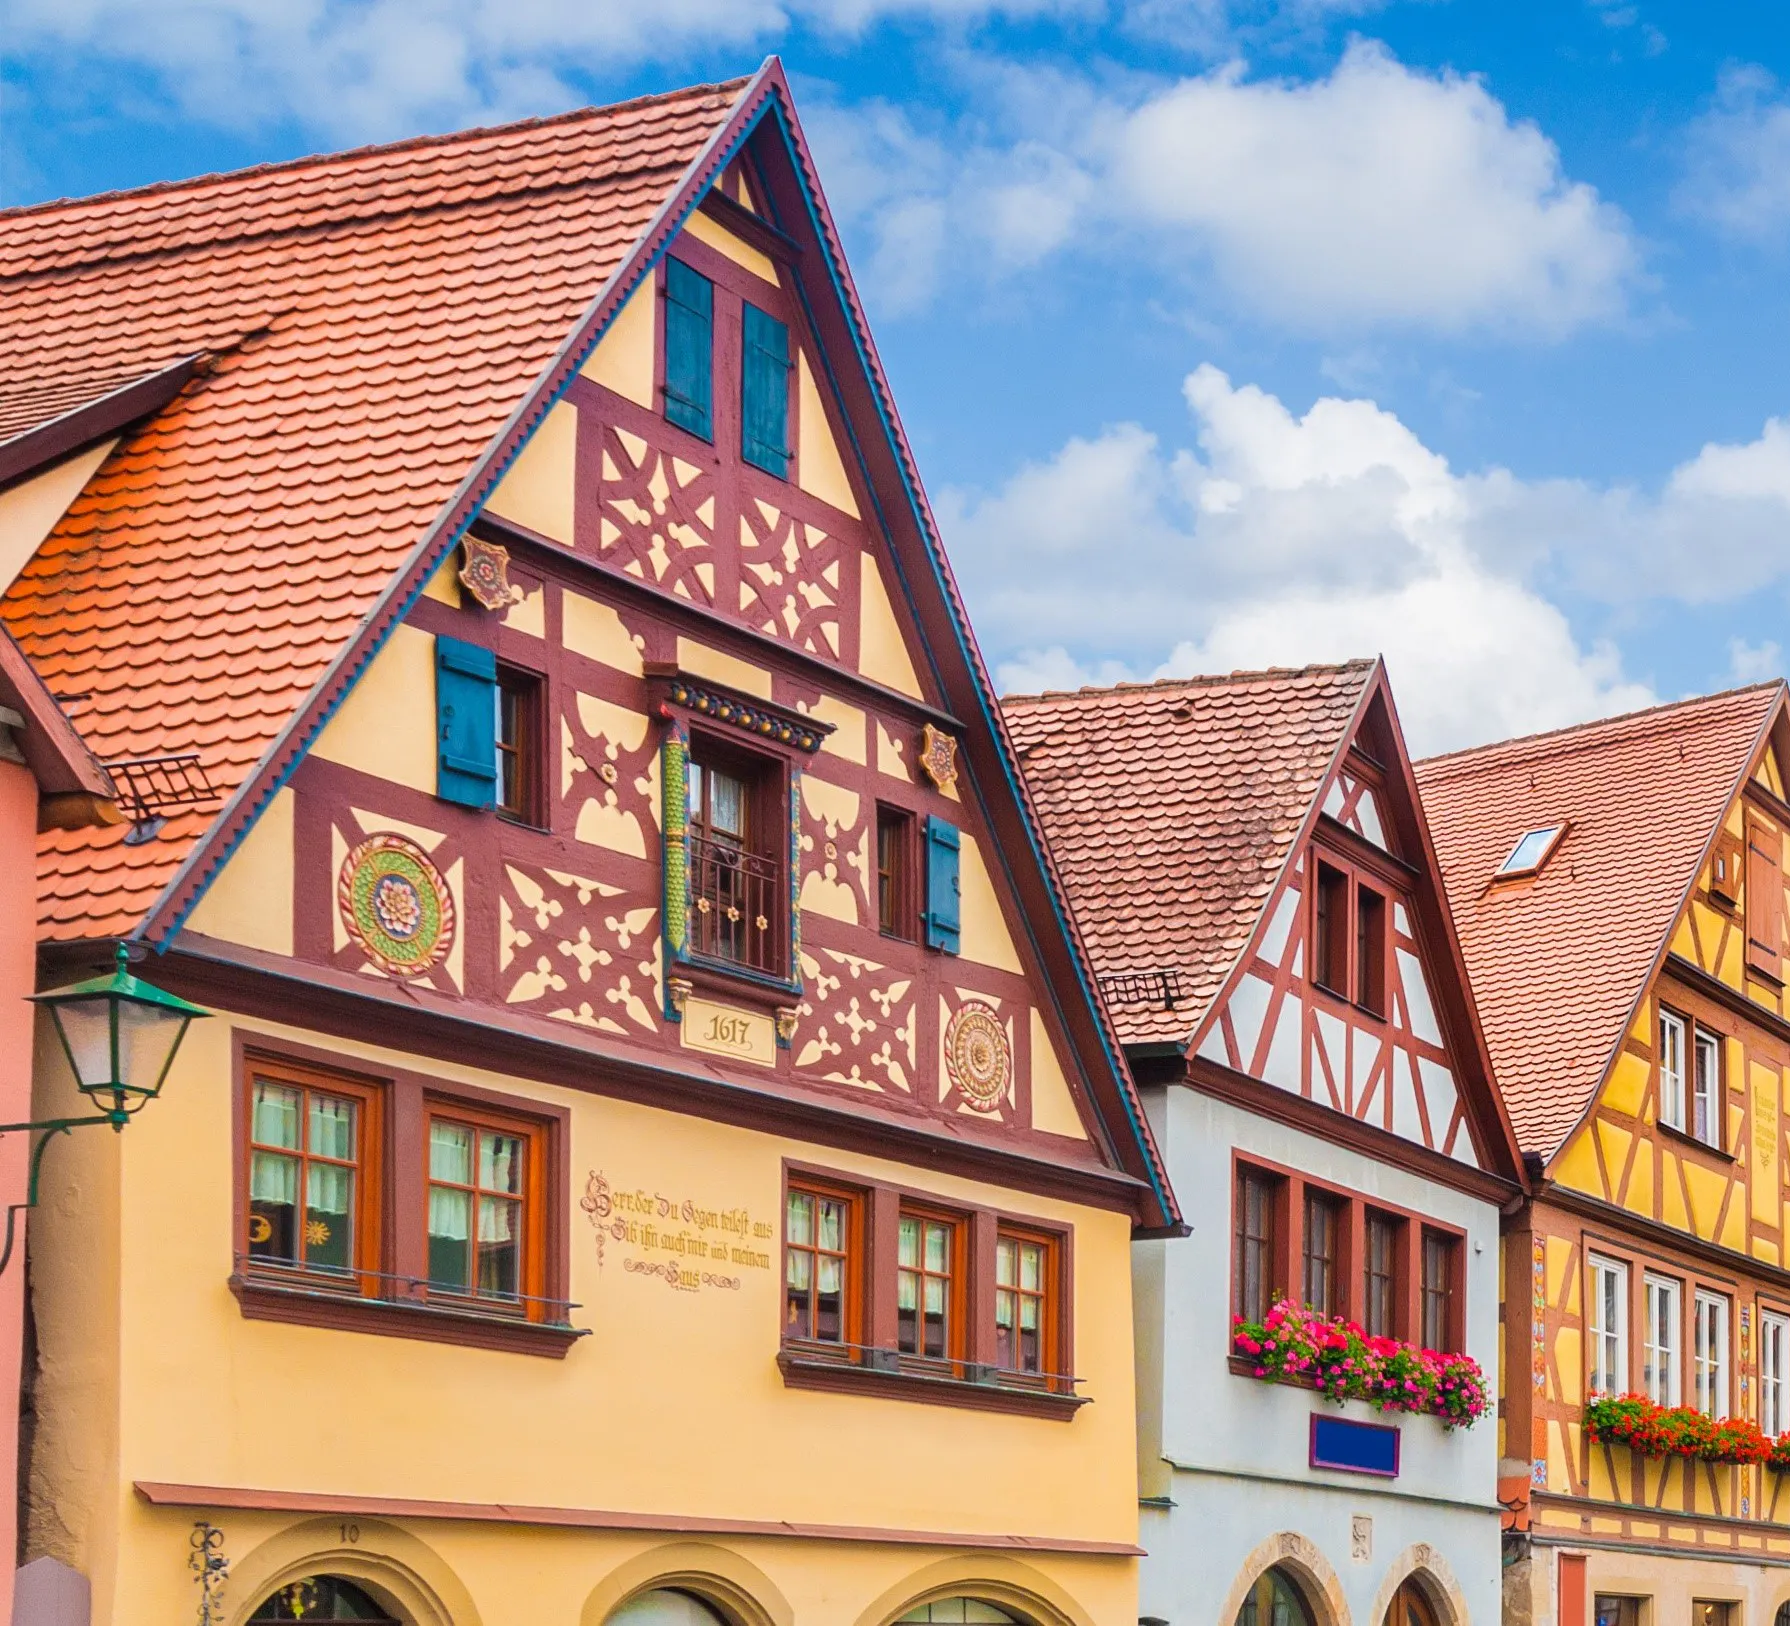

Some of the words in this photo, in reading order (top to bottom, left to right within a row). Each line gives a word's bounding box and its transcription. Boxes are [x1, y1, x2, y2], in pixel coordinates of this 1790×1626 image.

[703, 1013, 752, 1046] 1617
[654, 1192, 679, 1220] Du
[753, 1221, 773, 1240] aus
[661, 1230, 690, 1257] auch
[687, 1235, 708, 1258] mir
[711, 1240, 729, 1261] und
[664, 1260, 700, 1288] Haus
[340, 1524, 360, 1544] 10
